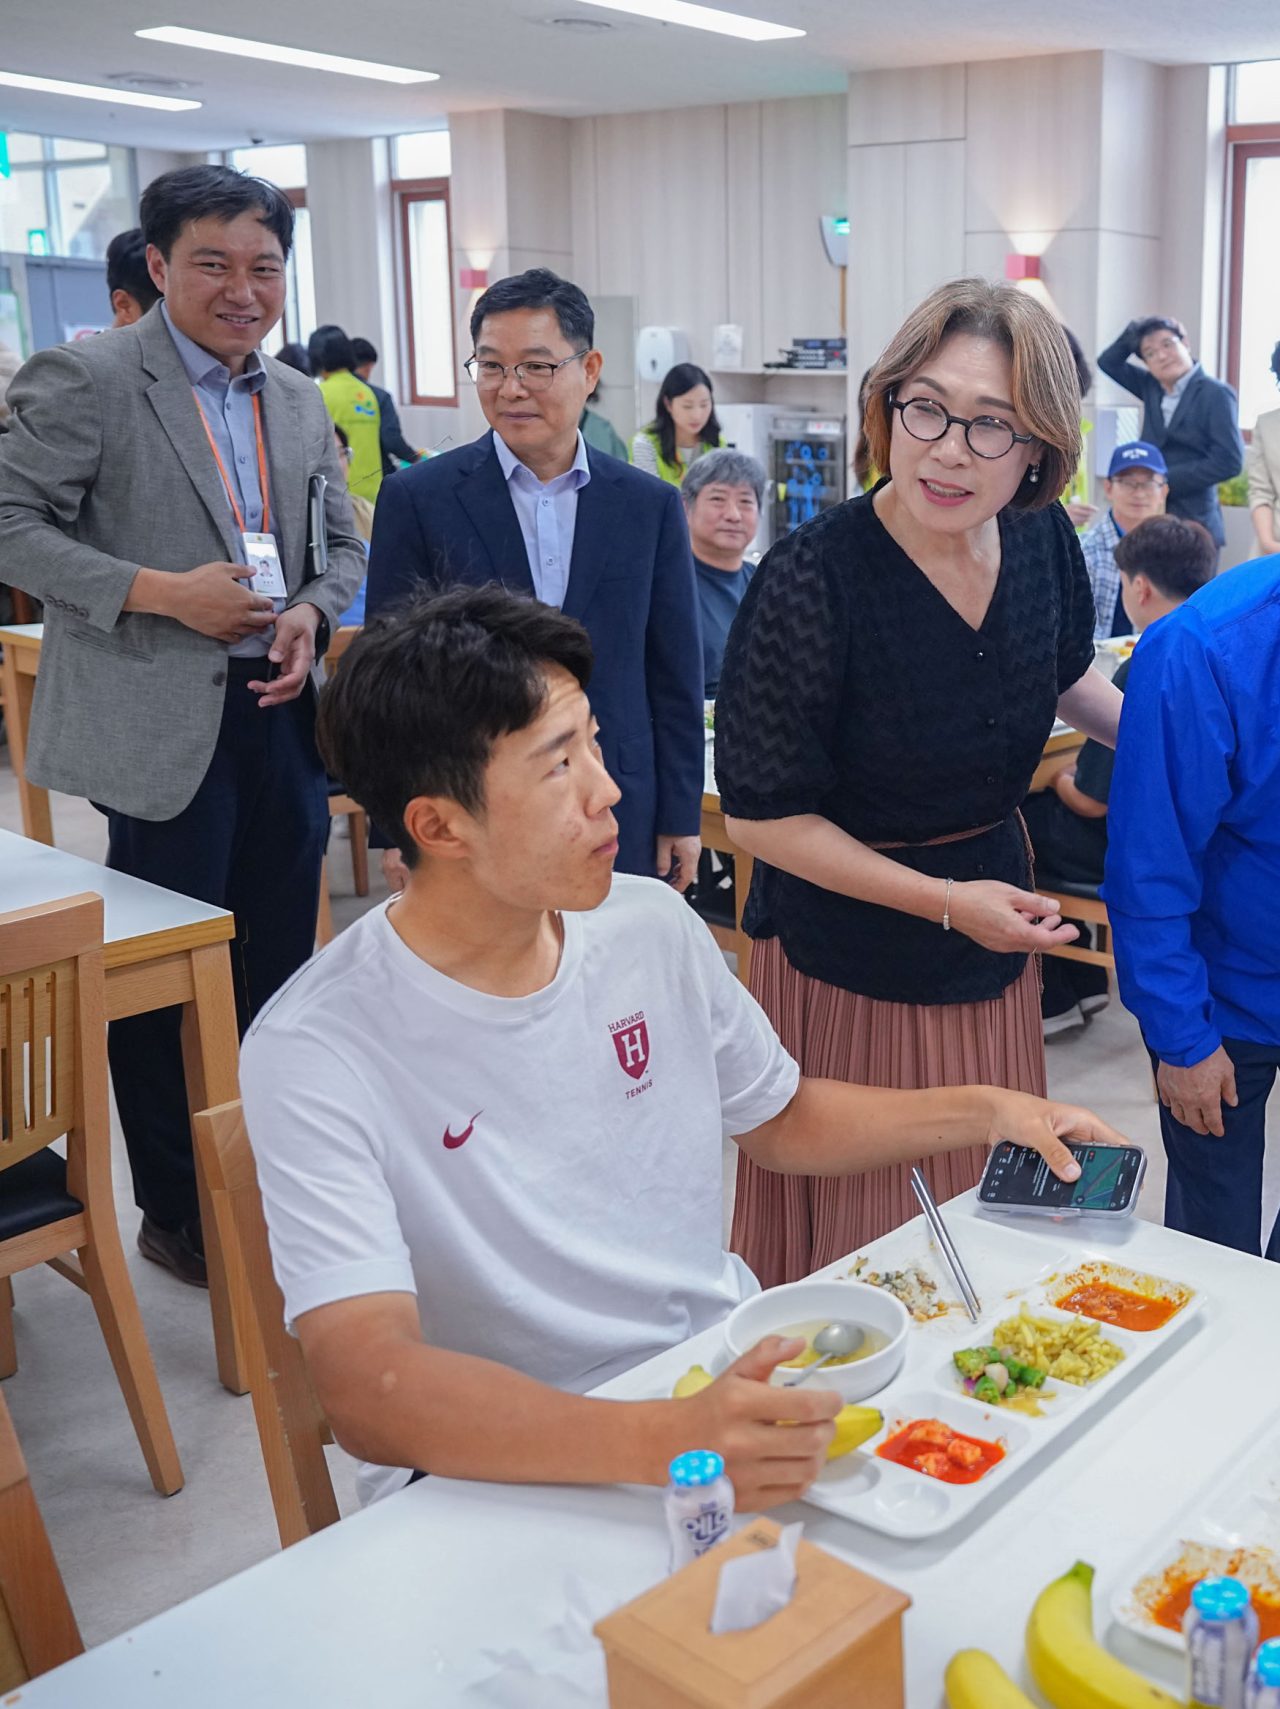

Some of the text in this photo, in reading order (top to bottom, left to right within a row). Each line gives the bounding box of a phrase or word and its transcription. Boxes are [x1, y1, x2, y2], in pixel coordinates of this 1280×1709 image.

[608, 1010, 645, 1033] HARVARD
[621, 1028, 646, 1067] H
[625, 1079, 653, 1100] TENNIS
